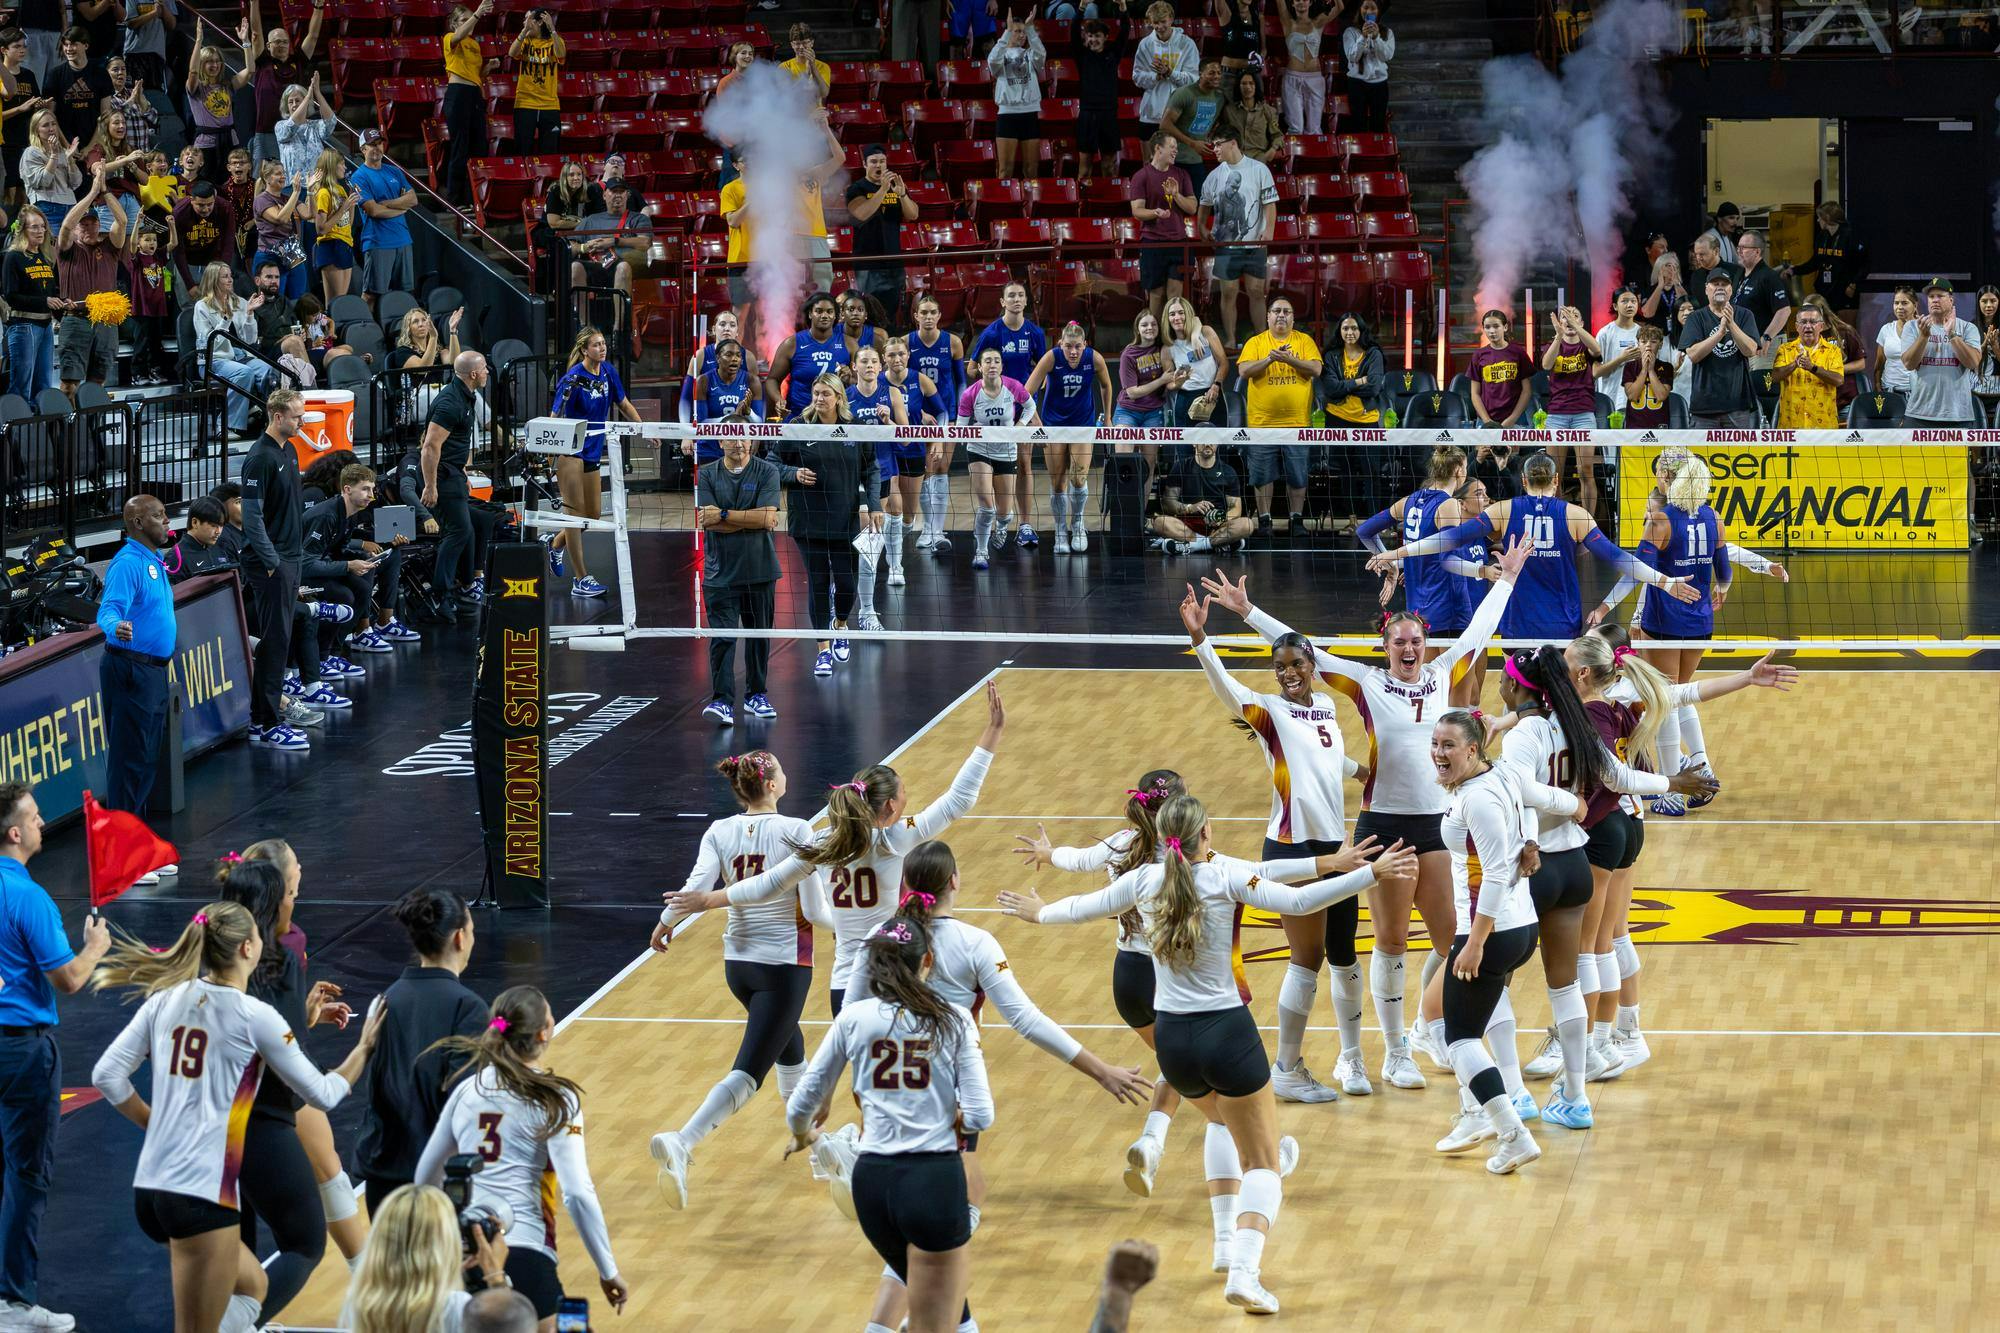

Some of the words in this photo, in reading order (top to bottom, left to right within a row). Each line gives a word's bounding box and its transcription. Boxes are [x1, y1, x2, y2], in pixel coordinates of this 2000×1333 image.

[811, 352, 833, 361] TCU
[919, 357, 940, 367] TCU
[816, 361, 829, 376] 7
[1490, 364, 1517, 372] MONSTER
[1062, 375, 1083, 384] TCU
[1267, 375, 1297, 386] STATE
[1490, 371, 1516, 381] BLOCK
[1063, 385, 1082, 398] 17
[718, 395, 741, 405] TCU
[857, 407, 878, 416] TCU
[984, 407, 1004, 417] TCU
[543, 430, 557, 438] DV
[696, 424, 745, 436] ARIZONA
[749, 425, 783, 437] STATE
[894, 426, 944, 438] ARIZONA
[948, 427, 982, 439] STATE
[1095, 428, 1145, 440] ARIZONA
[1149, 428, 1184, 441] STATE
[1298, 429, 1348, 441] ARIZONA
[1352, 429, 1387, 442] STATE
[1501, 429, 1552, 442] ARIZONA
[1555, 430, 1591, 442] STATE
[1706, 430, 1757, 442] ARIZONA
[1761, 430, 1796, 442] STATE
[1912, 430, 1963, 442] ARIZONA
[1967, 430, 2000, 442] STATE
[535, 437, 565, 447] SPORT
[1405, 506, 1423, 540] 9
[1522, 513, 1555, 549] 10
[1739, 529, 1832, 541] CREDIT
[1854, 529, 1938, 541] UNION
[1686, 522, 1708, 557] 11
[1469, 544, 1485, 559] TCU
[182, 636, 234, 709] WILL
[503, 627, 540, 728] STATE
[567, 695, 660, 732] MARKET
[1411, 699, 1425, 723] 7
[1316, 725, 1333, 749] 5
[1547, 748, 1572, 788] 10
[505, 735, 541, 879] ARIZONA
[830, 866, 880, 909] 20
[169, 1025, 208, 1079] 19
[870, 1039, 931, 1090] 25
[477, 1112, 504, 1163] 3
